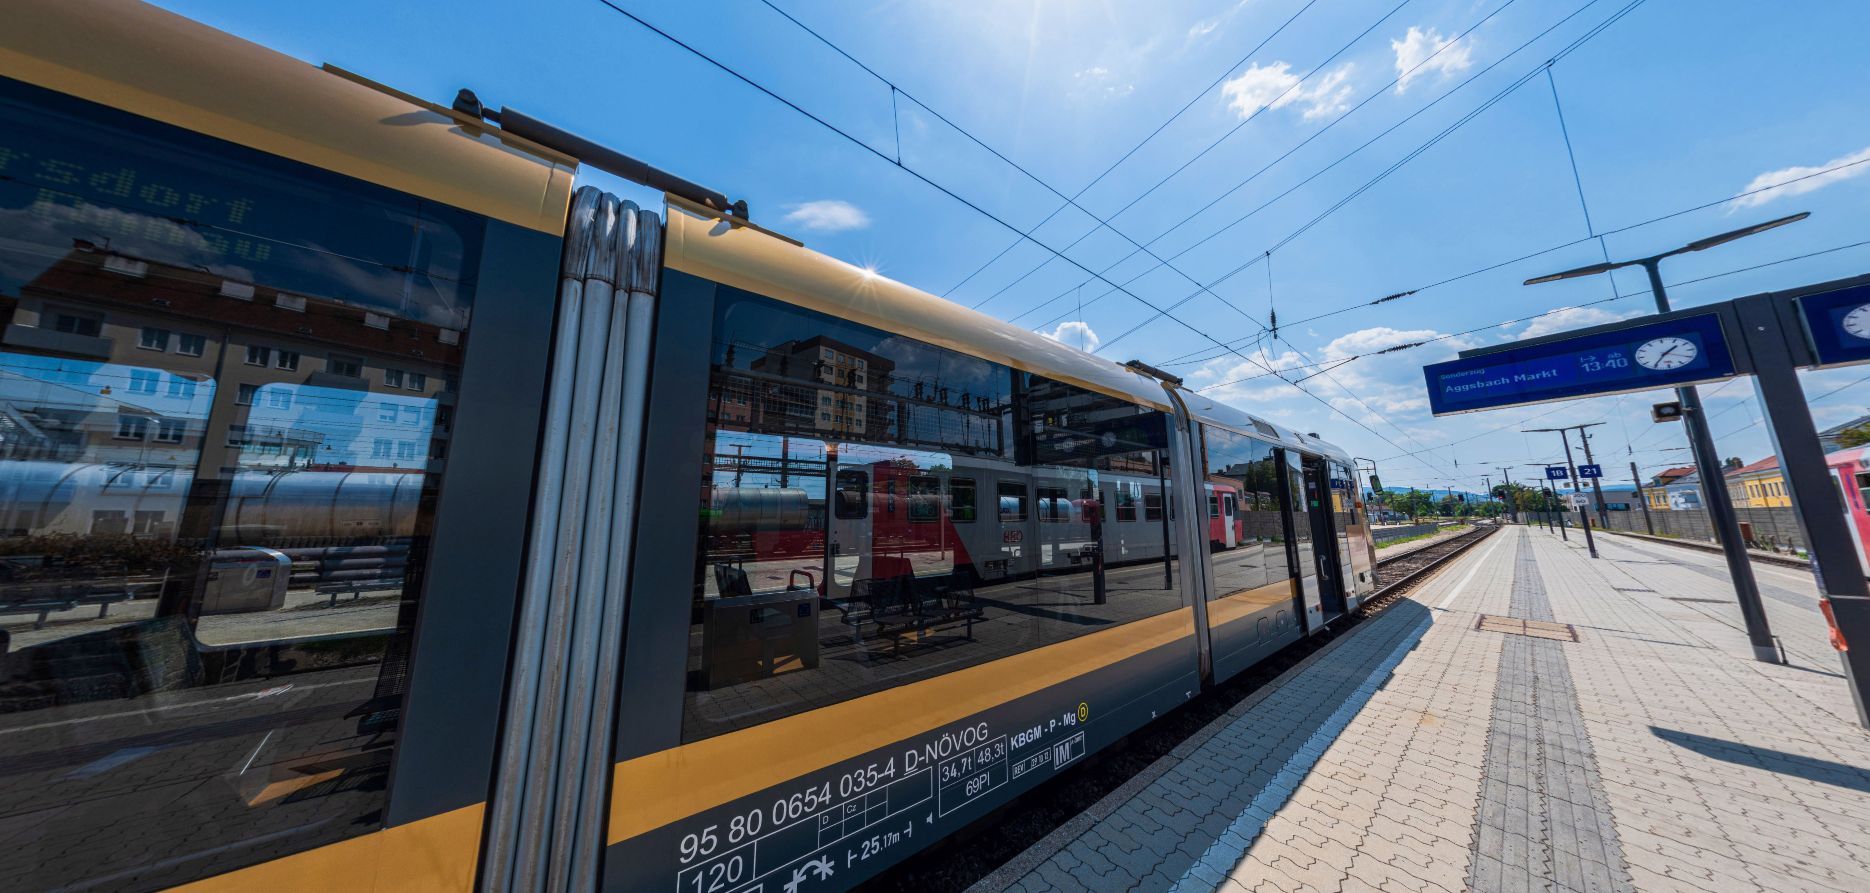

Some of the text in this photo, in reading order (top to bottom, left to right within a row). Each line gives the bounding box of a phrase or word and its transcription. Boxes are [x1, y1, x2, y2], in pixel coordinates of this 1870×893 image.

[1440, 367, 1485, 380] Sonderzug
[1581, 357, 1629, 373] 13:40
[1445, 369, 1558, 394] Aggsbach Markt
[1583, 467, 1597, 475] 21
[1010, 724, 1042, 751] KBGM
[1050, 719, 1056, 733] P
[1063, 712, 1076, 727] Mg
[941, 742, 1005, 783] 34,7t 48,3t
[1055, 742, 1070, 766] IM
[1014, 764, 1024, 776] REV
[680, 721, 988, 864] 95 80 0654 035-4 D-NÖVOG
[822, 815, 829, 825] D
[691, 855, 743, 893] 120
